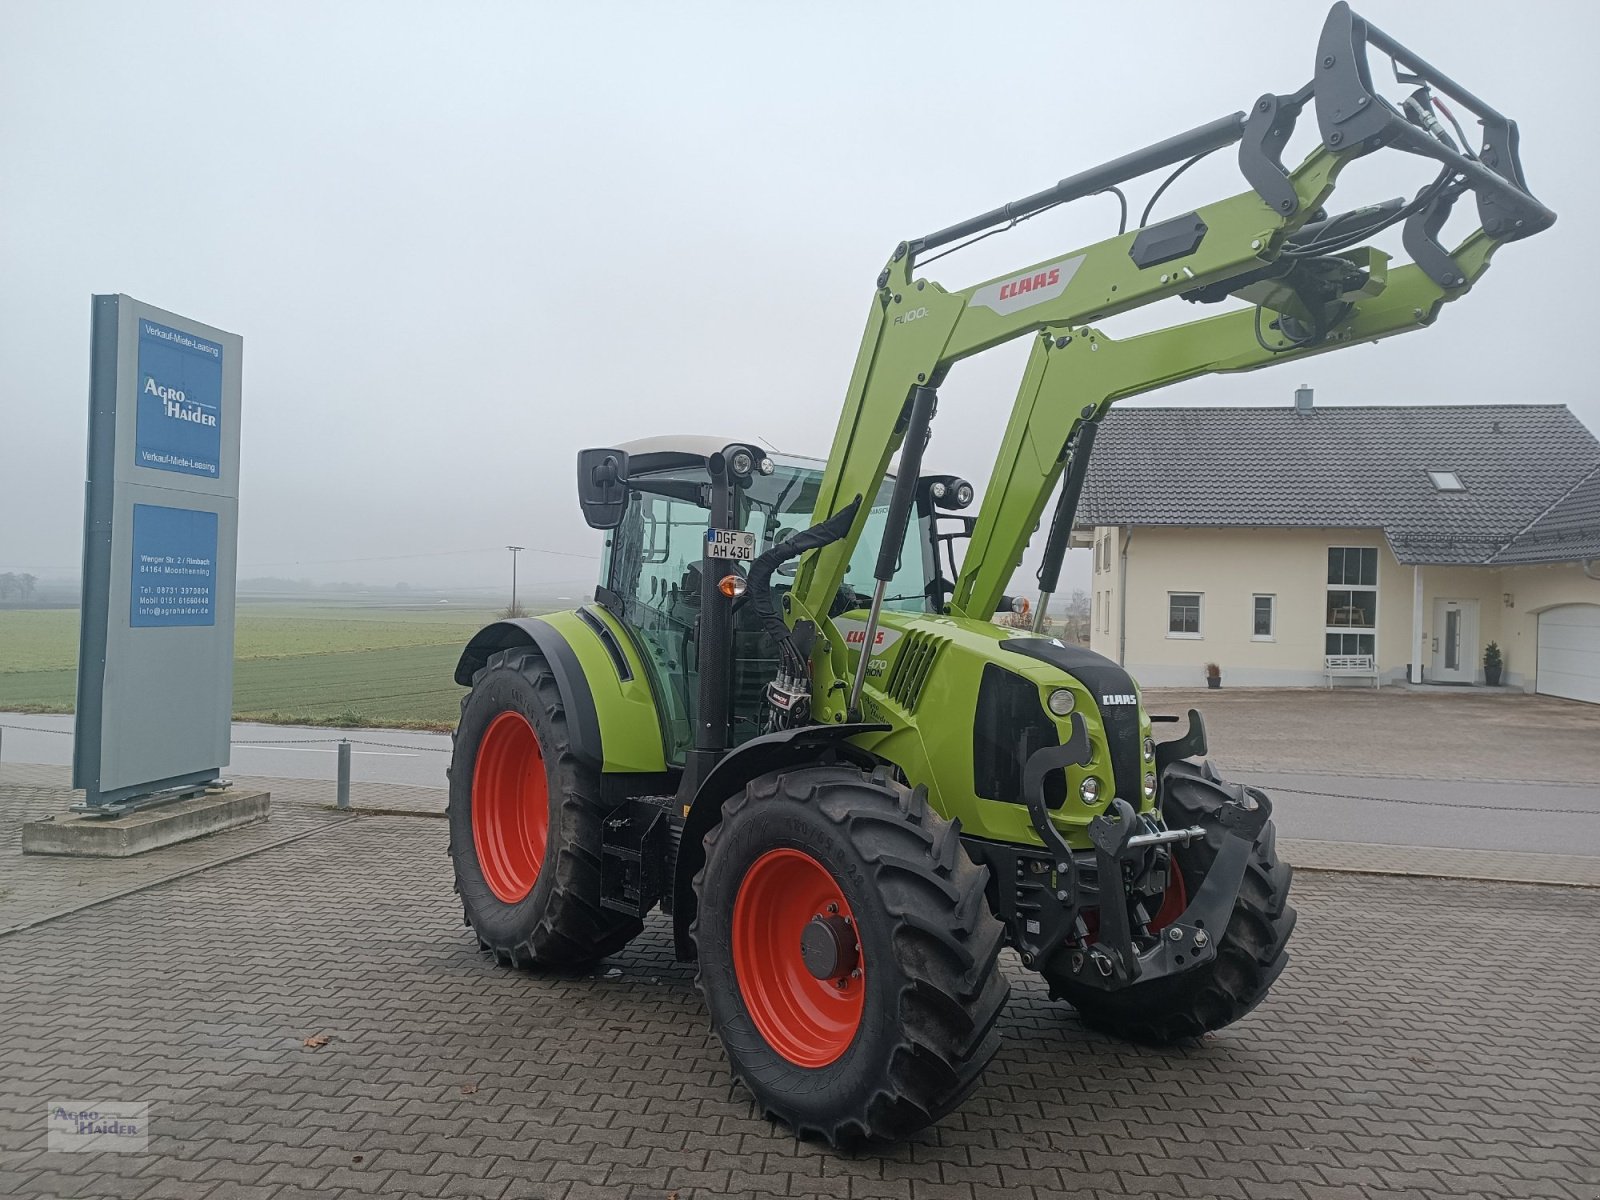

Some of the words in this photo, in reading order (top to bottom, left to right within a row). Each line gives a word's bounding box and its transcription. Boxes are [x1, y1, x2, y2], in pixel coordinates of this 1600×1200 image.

[999, 268, 1060, 301] CLAAS
[145, 324, 219, 357] Verkauf-Miete-Leasing
[142, 450, 216, 473] Verkauf-Miete-Leasing
[716, 531, 737, 544] DGF
[140, 555, 164, 564] Wenger
[140, 586, 154, 594] Tel.
[140, 596, 159, 604] Mobil
[160, 596, 177, 604] 0151
[847, 630, 885, 645] CLAS
[1102, 694, 1137, 706] CLAAS
